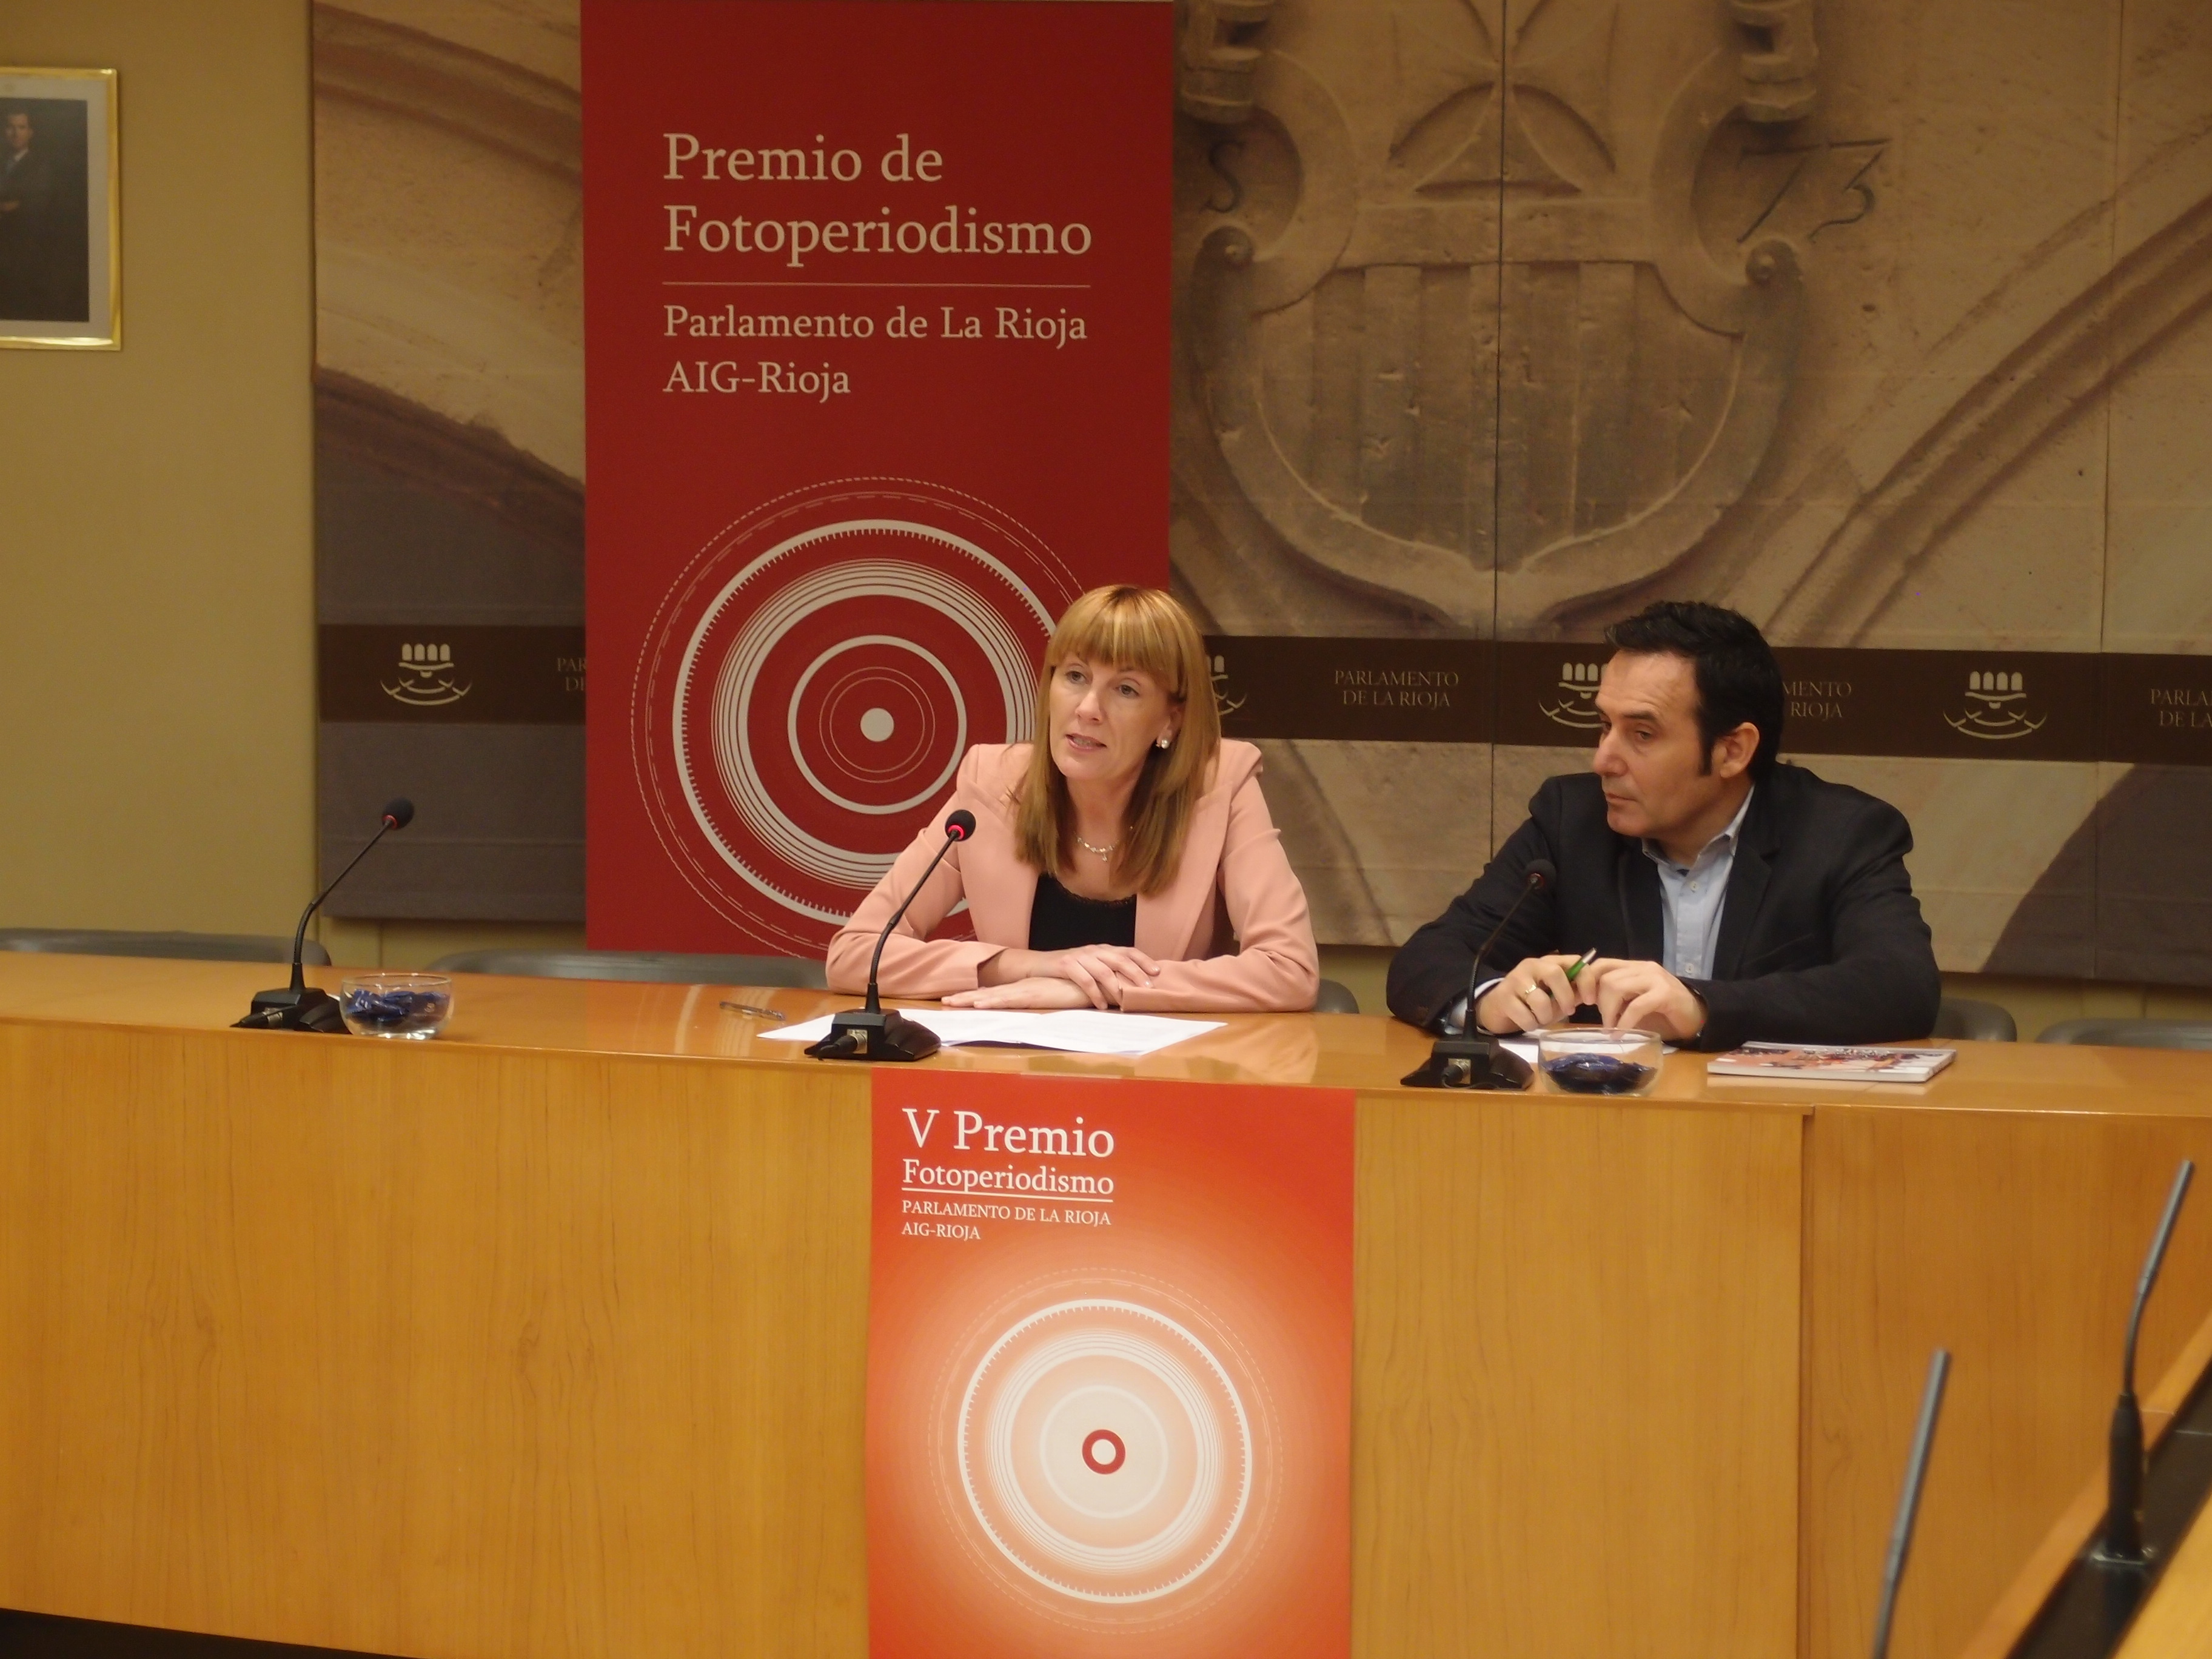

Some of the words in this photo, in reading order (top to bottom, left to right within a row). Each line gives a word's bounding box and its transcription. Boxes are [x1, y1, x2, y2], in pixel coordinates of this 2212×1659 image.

[663, 133, 863, 182] Premio
[881, 133, 943, 183] de
[663, 204, 1092, 268] Fotoperiodismo
[664, 304, 875, 338] Parlamento
[886, 306, 928, 339] de
[941, 307, 984, 339] La
[996, 307, 1088, 350] Rioja
[663, 361, 851, 404] AIG-Rioja
[1334, 669, 1460, 687] PARLAMENTO
[1343, 689, 1369, 706] DE
[1373, 690, 1395, 706] LA
[1399, 691, 1450, 710] RIOJA
[1791, 701, 1843, 722] RIOJA
[2150, 688, 2212, 707] PARLA
[2160, 709, 2186, 728] DE
[2190, 711, 2212, 729] LA
[902, 1108, 940, 1148] V
[953, 1110, 1115, 1158] Premio
[902, 1158, 1114, 1195] Fotoperiodismo
[902, 1199, 1011, 1219] PARLAMENTO
[1014, 1207, 1036, 1221] DE
[1039, 1208, 1061, 1222] LA
[1064, 1210, 1112, 1227] RIOJA
[901, 1221, 981, 1242] AIG-RIOJA
